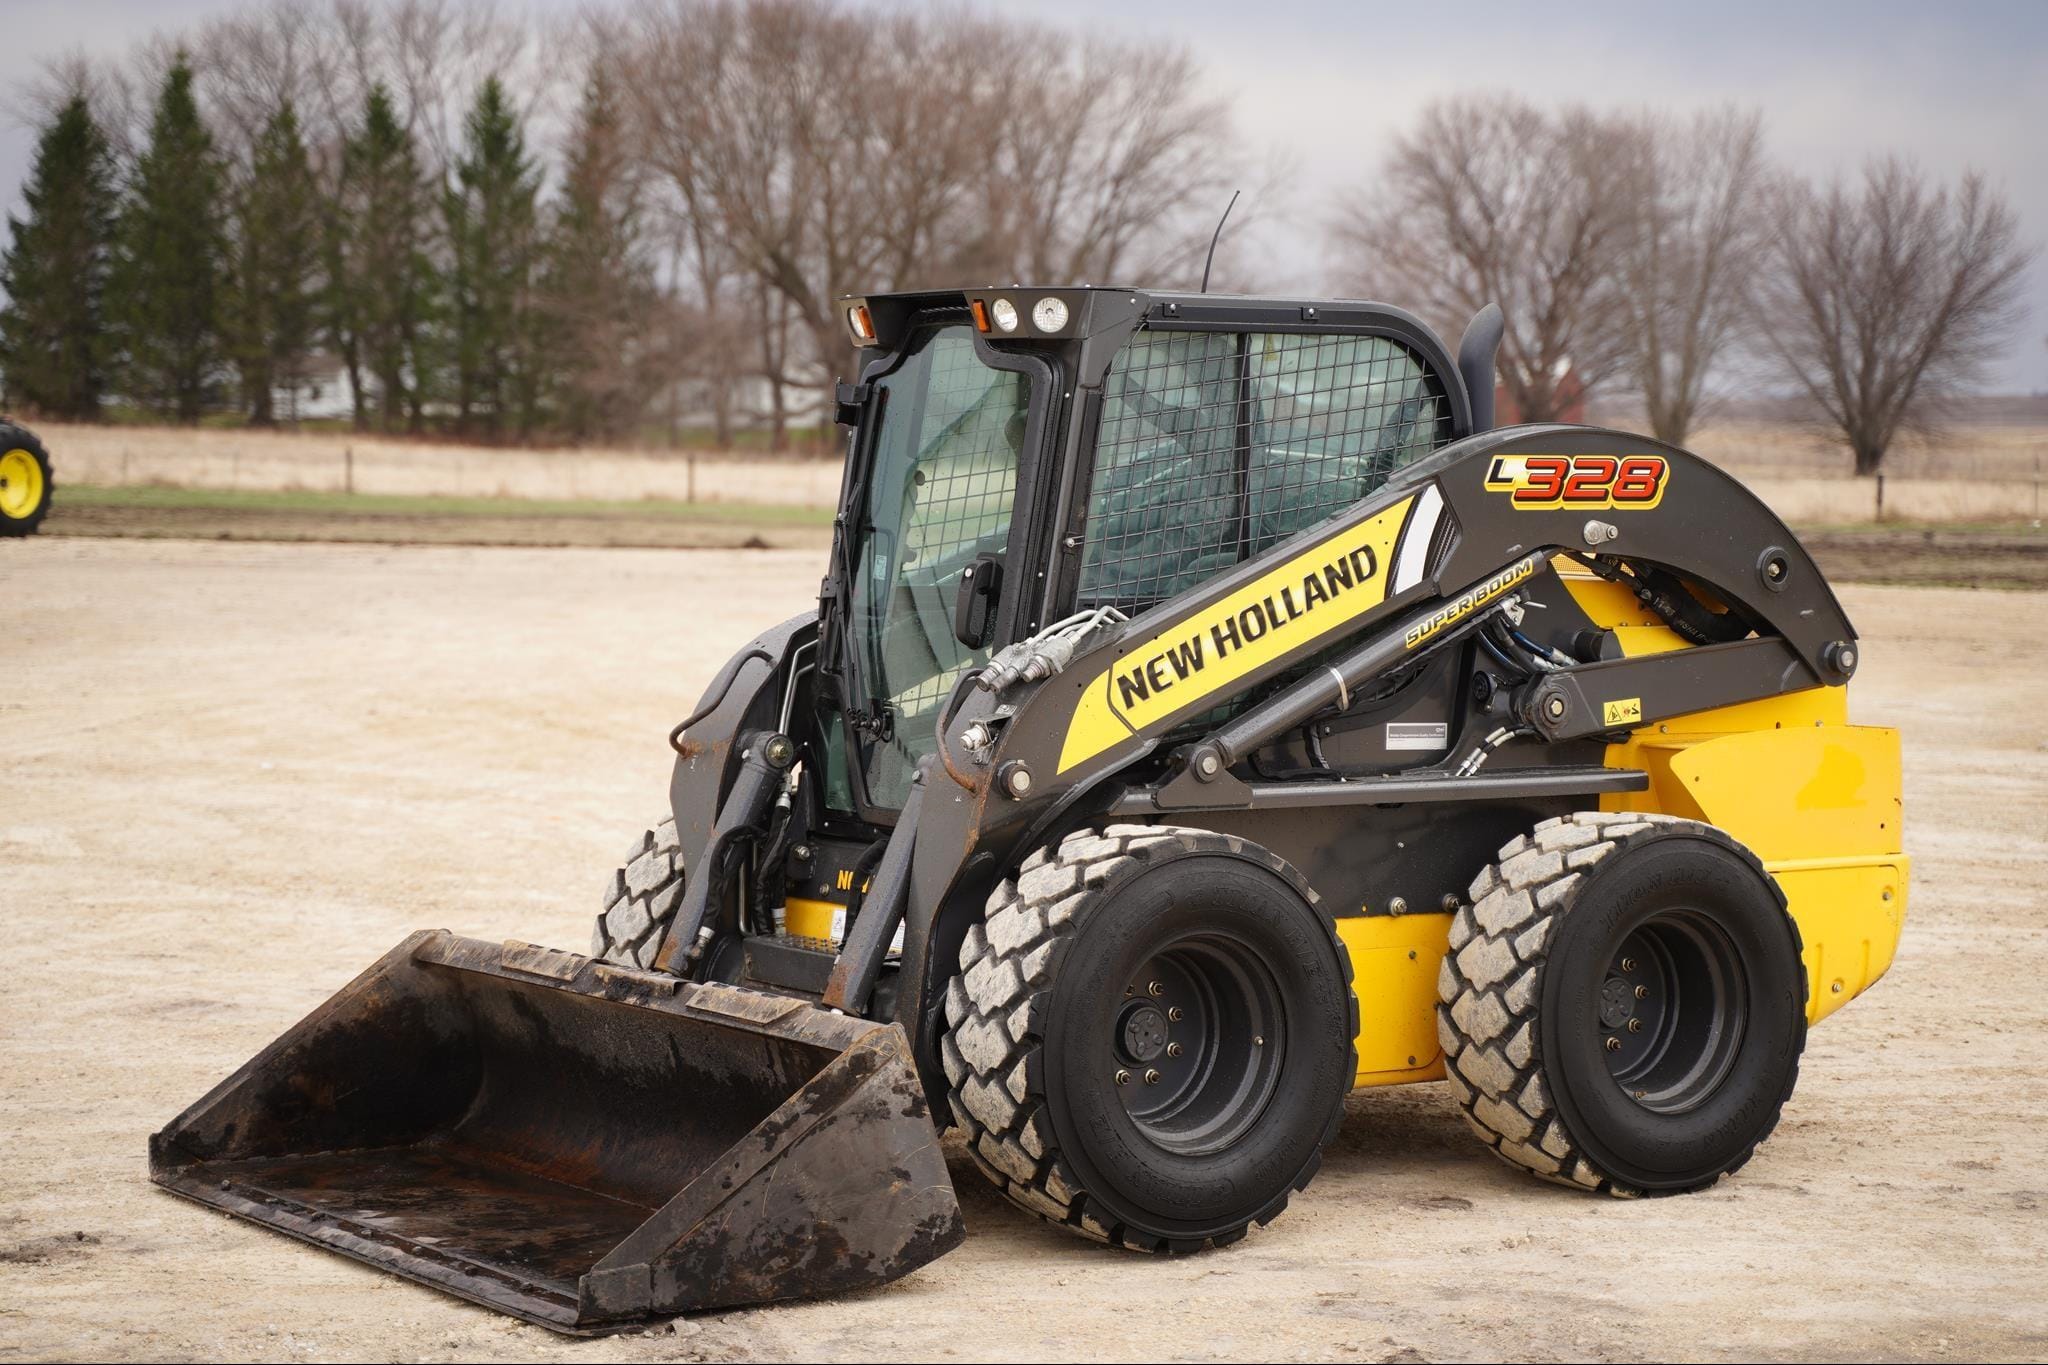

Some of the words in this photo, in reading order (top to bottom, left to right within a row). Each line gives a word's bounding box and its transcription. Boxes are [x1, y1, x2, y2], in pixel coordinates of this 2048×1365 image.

[1486, 457, 1667, 504] L328
[1116, 632, 1205, 711] NEW
[1210, 543, 1379, 660] HOLLAND
[1406, 596, 1473, 647] SUPER
[1475, 558, 1532, 606] BOOM
